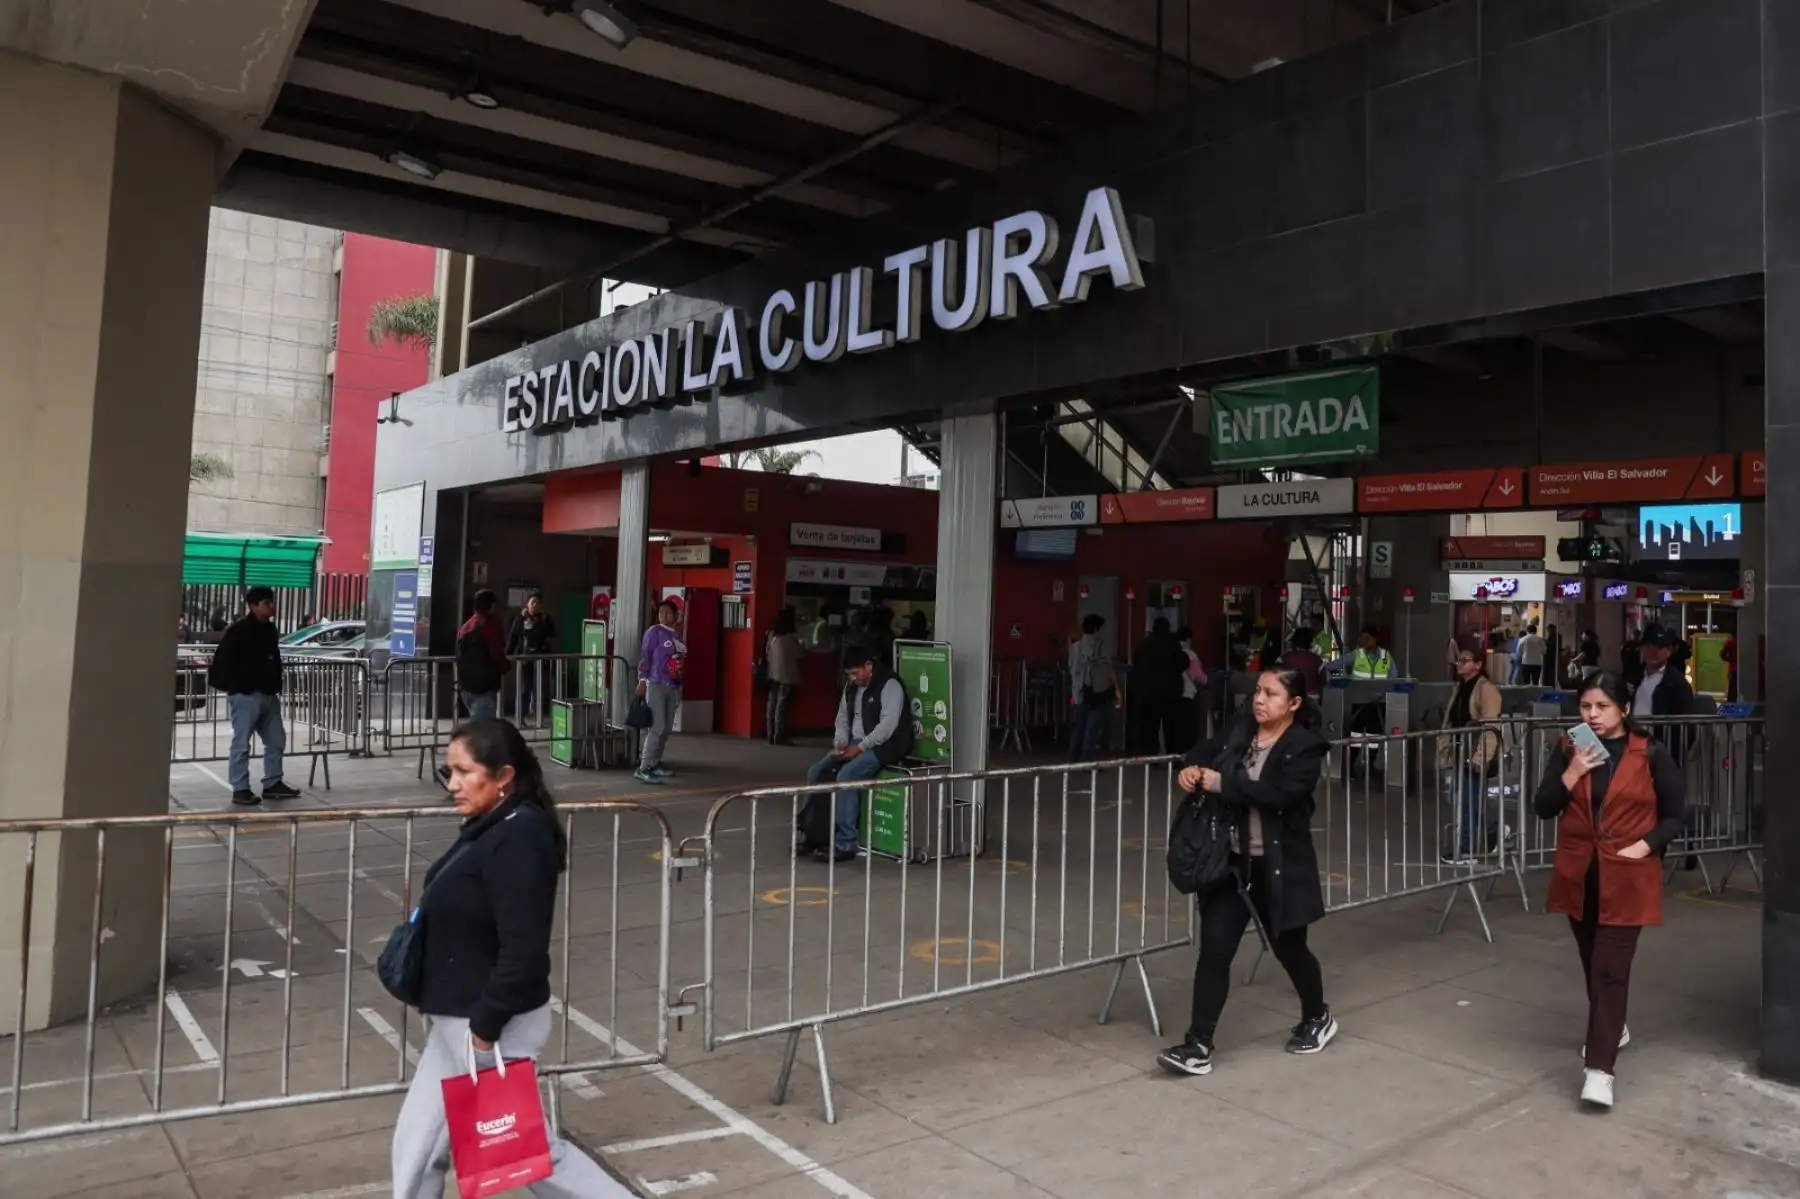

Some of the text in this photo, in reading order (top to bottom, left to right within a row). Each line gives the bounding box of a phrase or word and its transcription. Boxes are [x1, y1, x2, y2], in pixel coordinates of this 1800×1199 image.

[502, 186, 1145, 434] ESTACION LA CULTURA
[1217, 395, 1369, 444] ENTRADA
[1539, 467, 1667, 483] Dirección Villa El Salvador
[1399, 483, 1415, 493] Villa
[1426, 480, 1463, 492] Salvador
[1243, 490, 1321, 508] LA CULTURA
[796, 528, 876, 545] Venta de tarjetas
[1375, 544, 1389, 564] S
[475, 1113, 517, 1131] Eucerin
